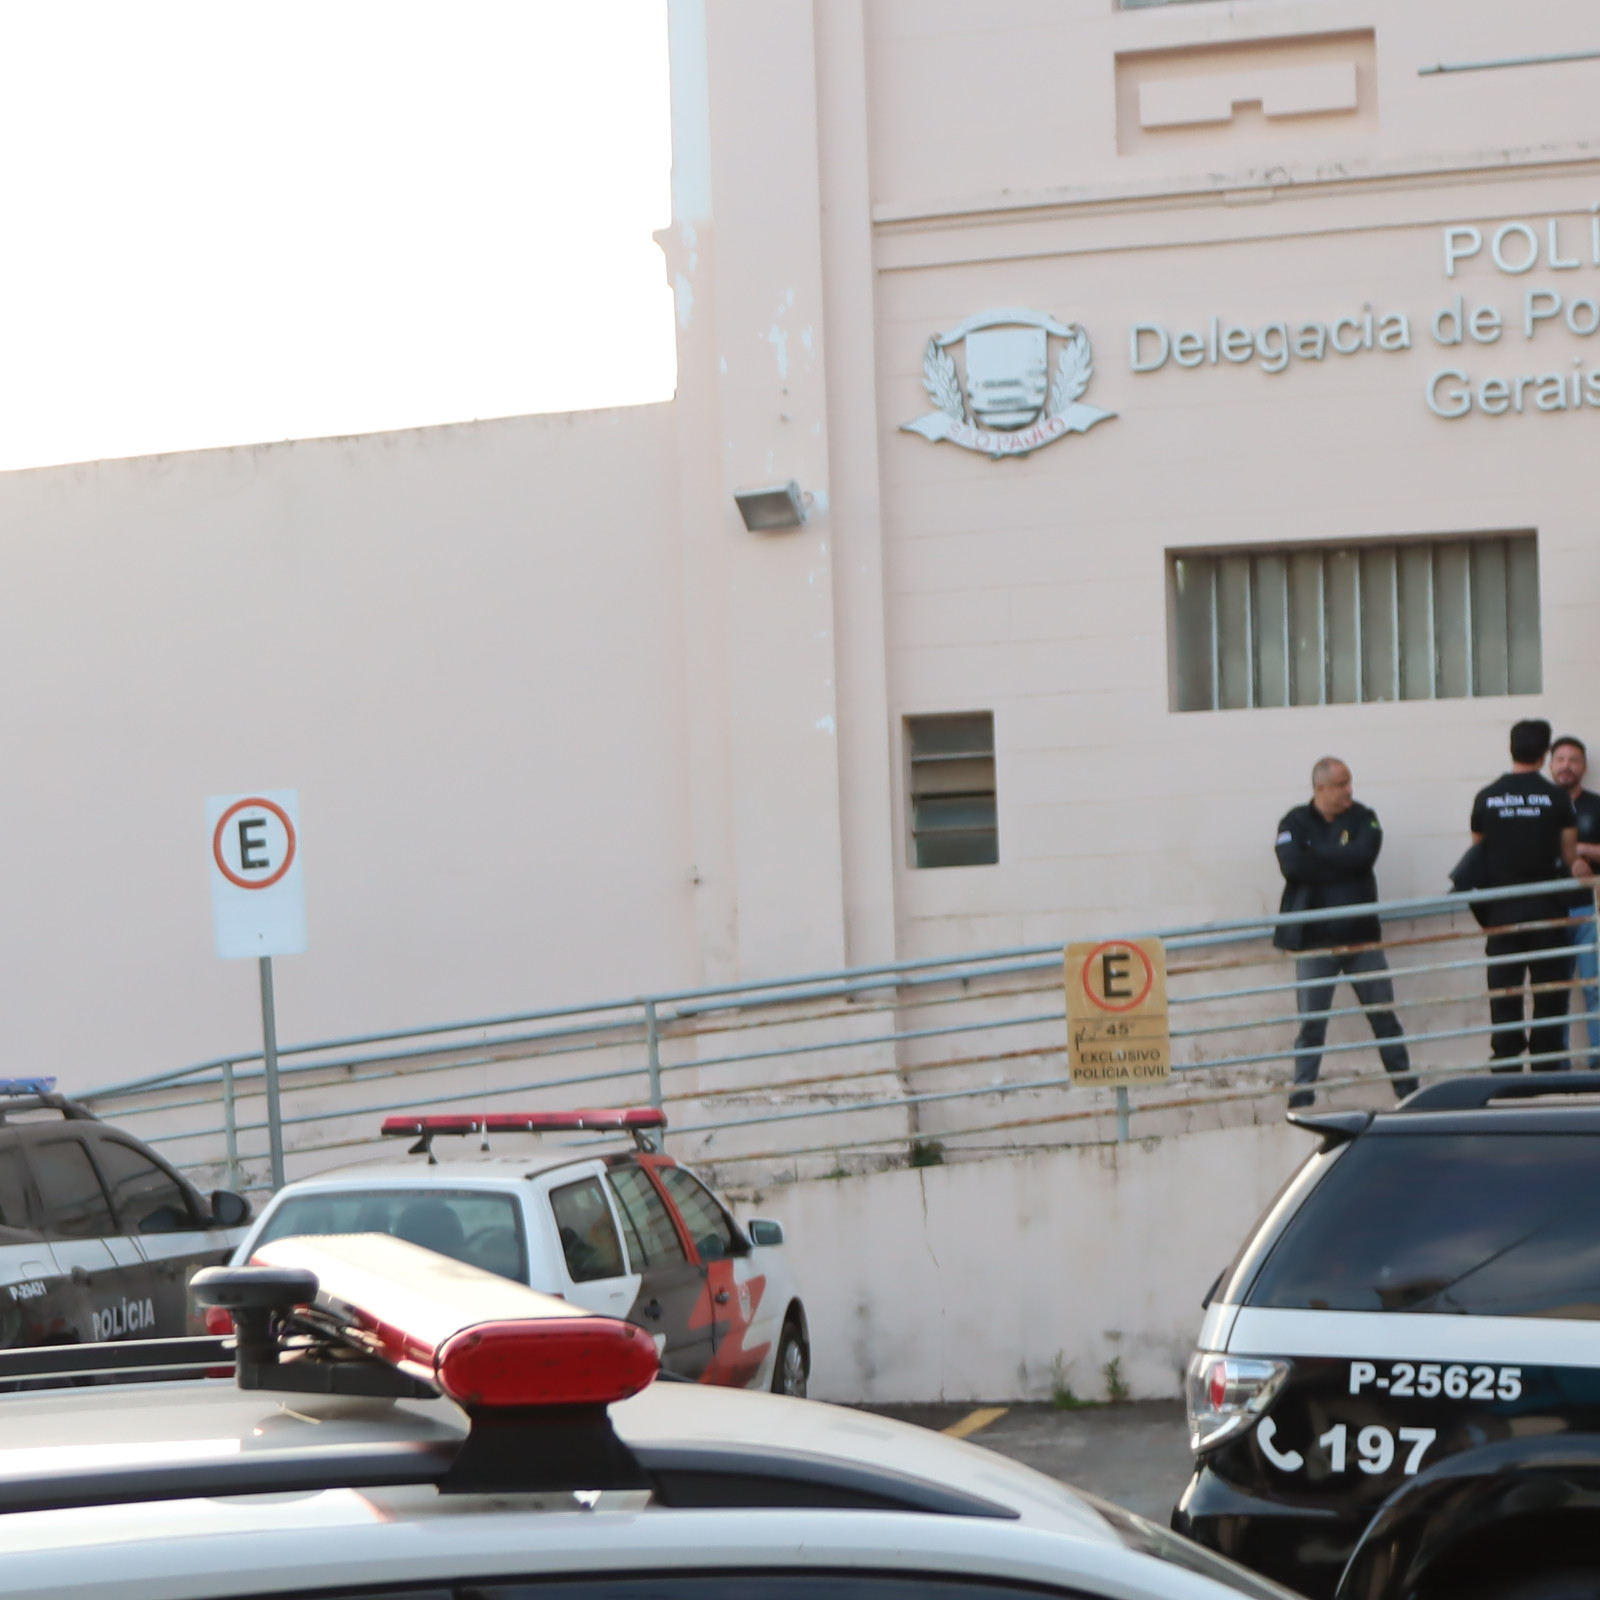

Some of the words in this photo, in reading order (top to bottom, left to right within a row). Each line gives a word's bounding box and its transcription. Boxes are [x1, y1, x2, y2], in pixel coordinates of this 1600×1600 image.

[1129, 304, 1411, 374] Delegacia
[1431, 295, 1502, 345] de
[238, 817, 271, 871] E
[1102, 953, 1133, 998] E
[1081, 1049, 1162, 1065] EXCLUSIVO
[92, 1297, 156, 1342] POLÍCIA
[1349, 1361, 1522, 1400] P-25625
[1319, 1424, 1437, 1475] 197
